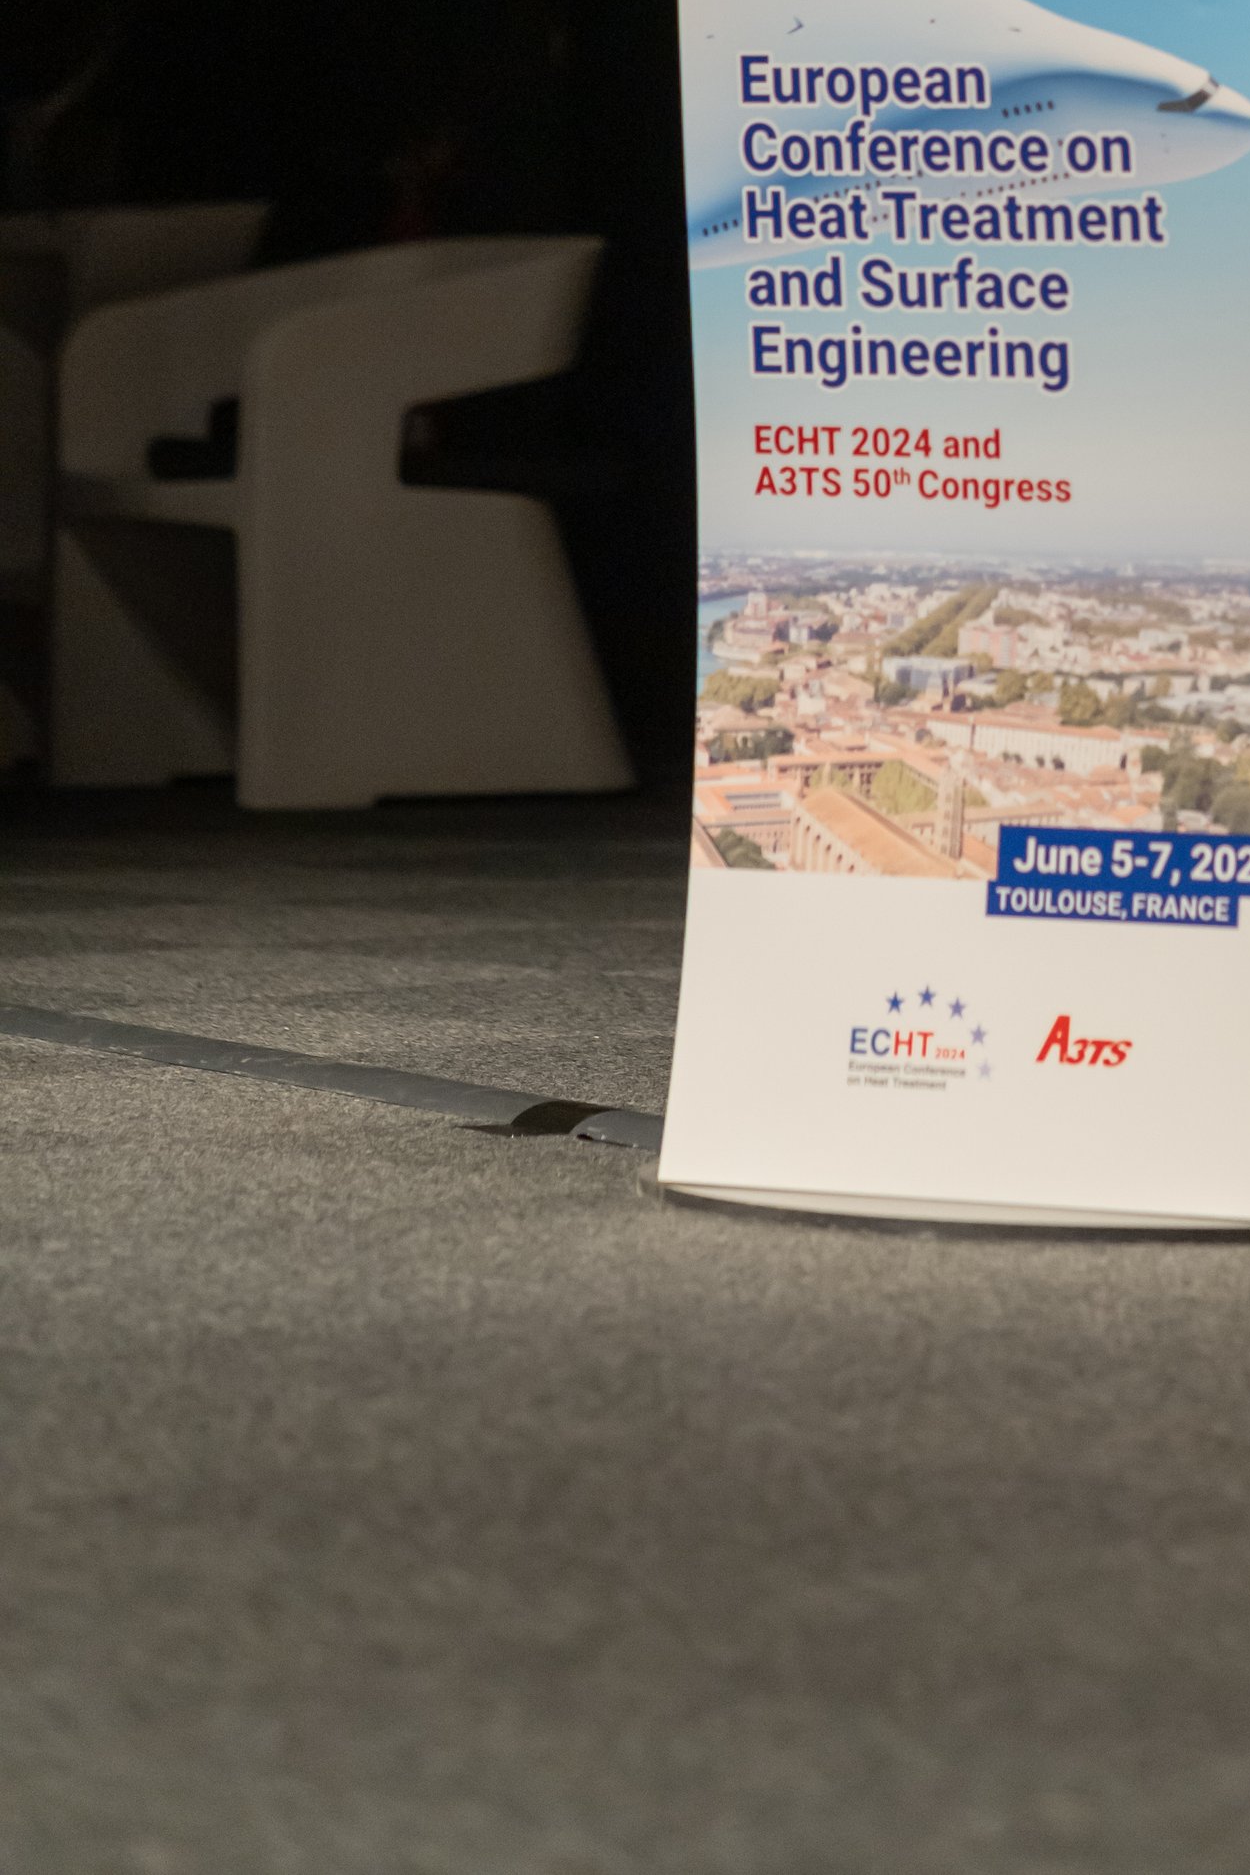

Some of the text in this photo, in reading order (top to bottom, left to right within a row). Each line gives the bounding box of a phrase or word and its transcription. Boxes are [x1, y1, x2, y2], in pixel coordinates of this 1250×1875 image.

[740, 55, 987, 116] European
[742, 122, 1132, 173] Conference on
[746, 190, 1164, 241] Heat Treatment
[748, 257, 1070, 309] and Surface
[752, 326, 1071, 392] Engineering
[754, 425, 1001, 460] ECHT 2024 and
[754, 466, 1072, 508] A3TS 50th Congress
[1013, 836, 1102, 875] June
[1111, 839, 1181, 887] 5-7,
[996, 886, 1231, 922] TOULOUSE, FRANCE
[849, 1028, 966, 1060] ECHT 2024
[1036, 1014, 1133, 1067] A3TS
[847, 1076, 947, 1091] on Heat Treatment
[848, 1061, 966, 1078] European Conference
